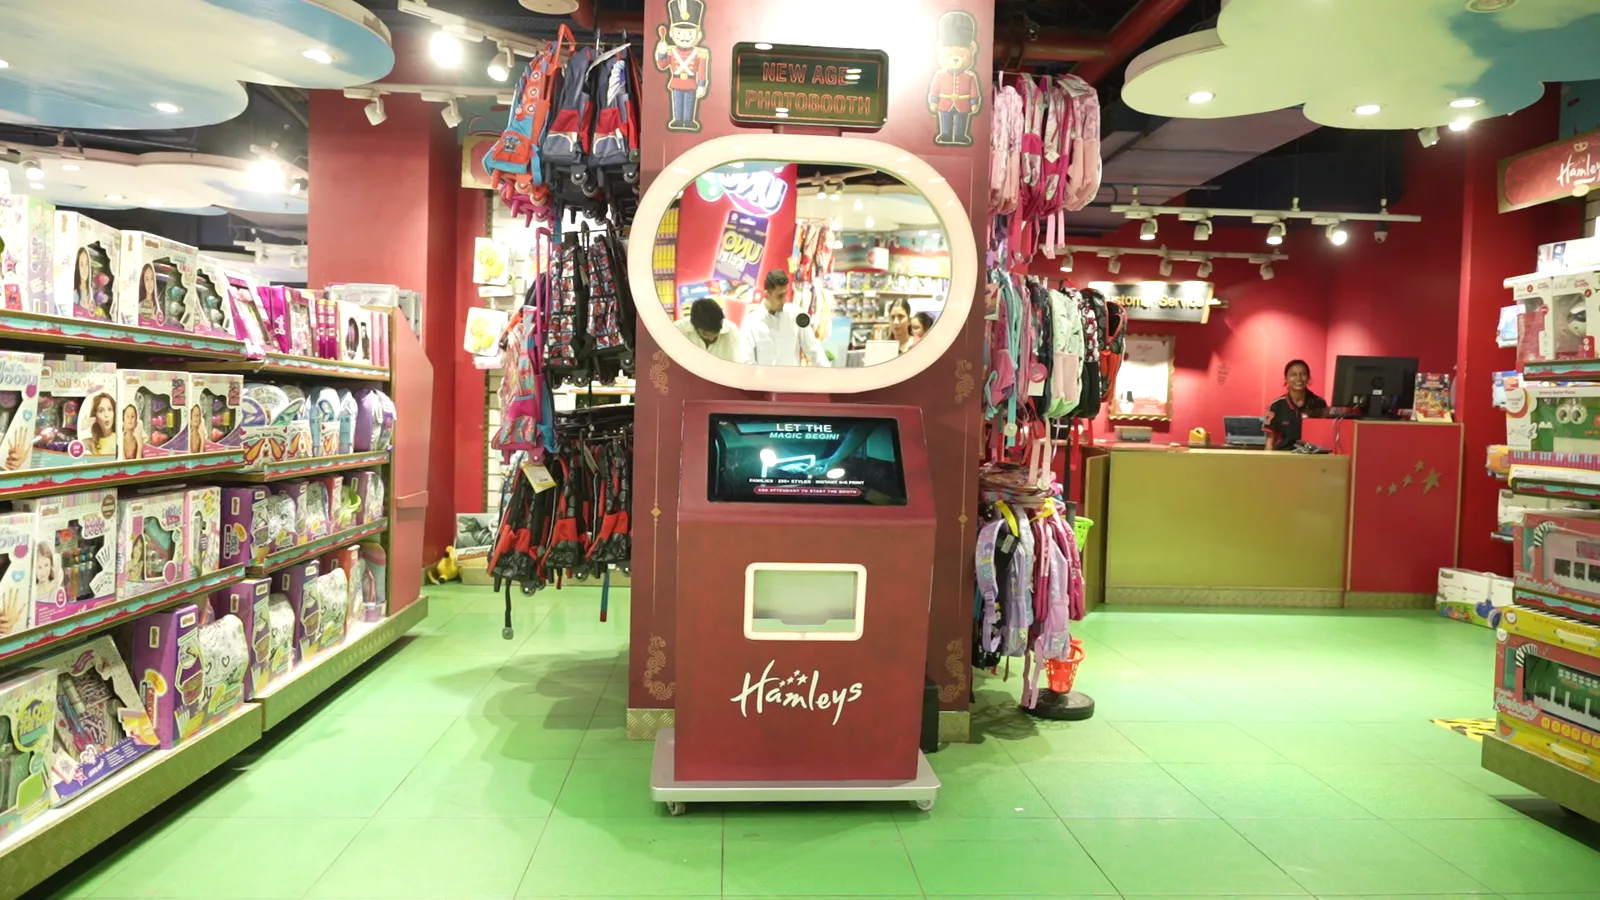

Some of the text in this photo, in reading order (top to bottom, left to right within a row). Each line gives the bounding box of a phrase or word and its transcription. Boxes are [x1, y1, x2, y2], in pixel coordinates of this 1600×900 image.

[762, 62, 851, 86] NEW AGE
[745, 89, 871, 116] PHOTOBOOTH
[1158, 294, 1205, 309] Service
[55, 378, 72, 388] Nail
[776, 423, 833, 433] LET THE
[730, 659, 863, 726] Hamleys
